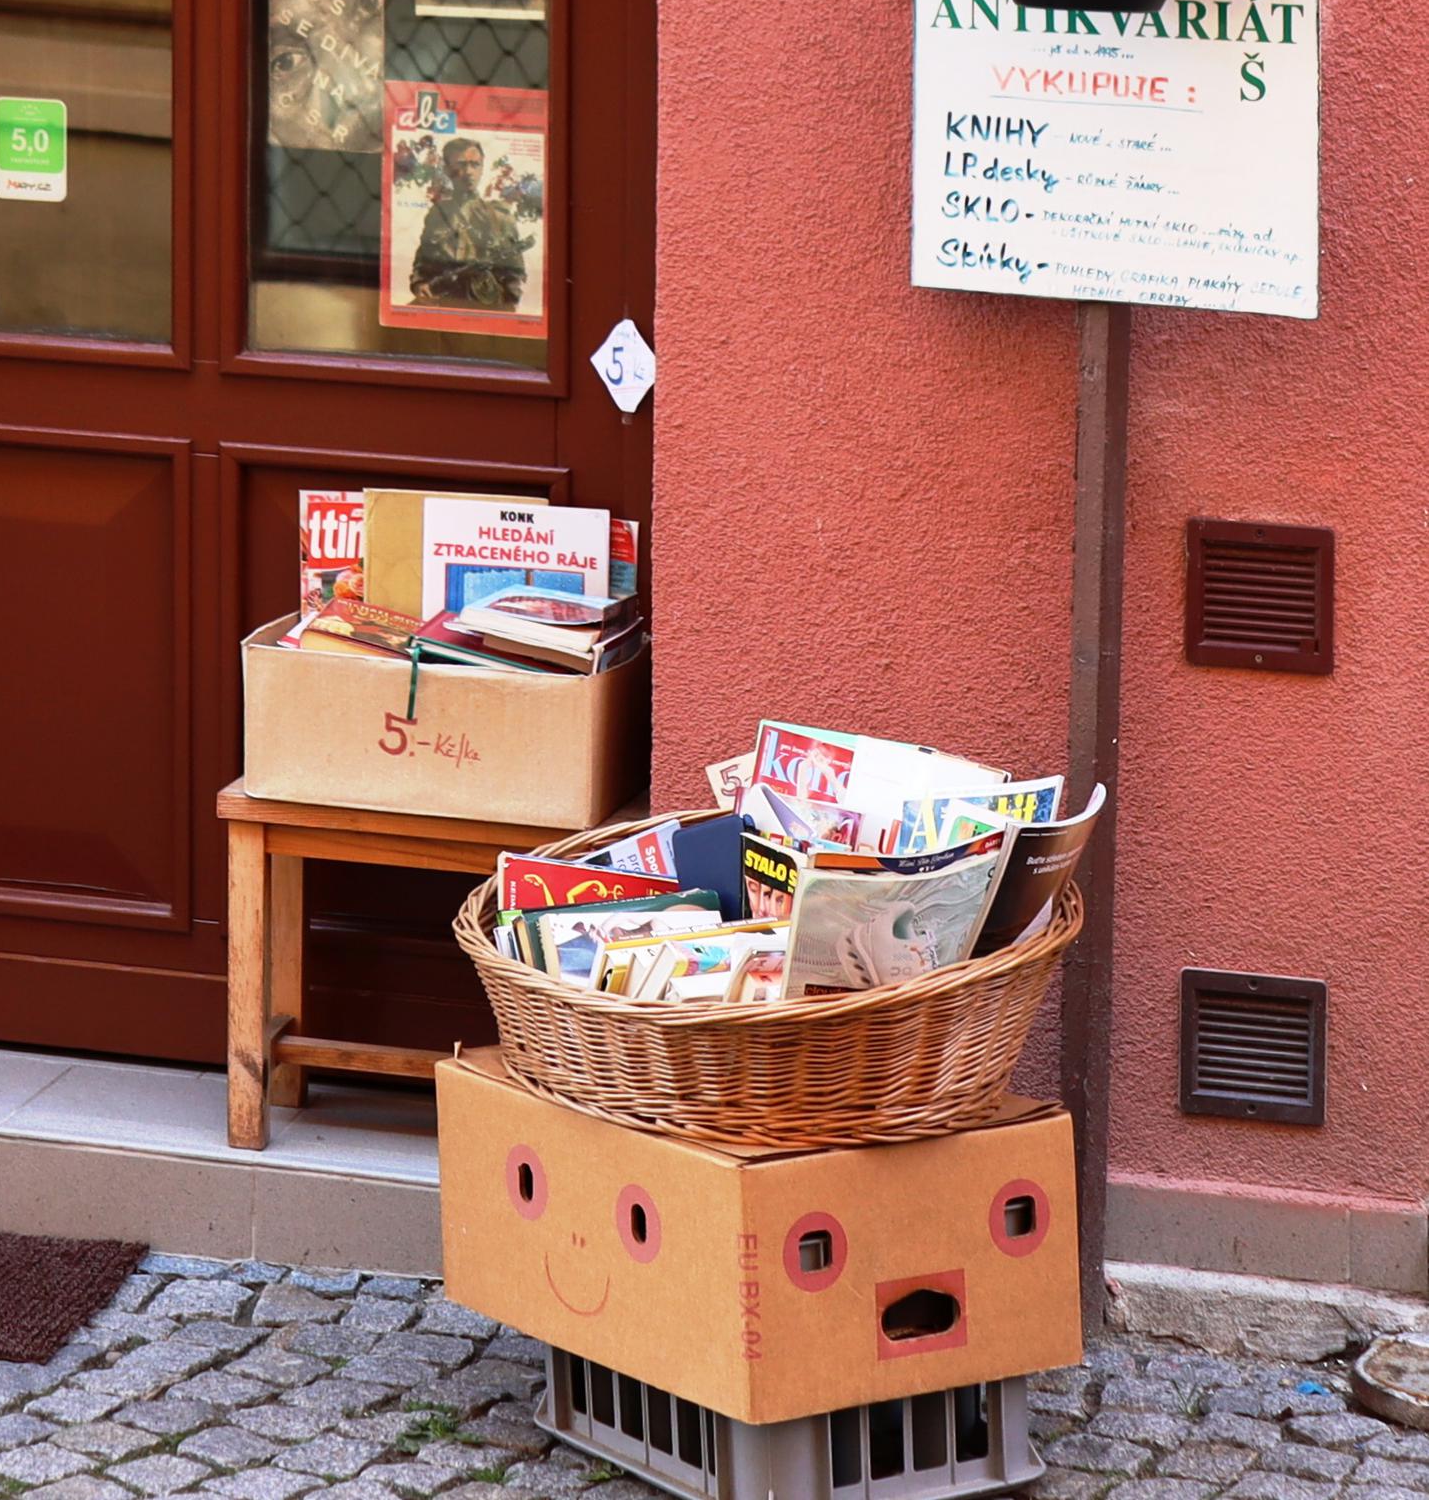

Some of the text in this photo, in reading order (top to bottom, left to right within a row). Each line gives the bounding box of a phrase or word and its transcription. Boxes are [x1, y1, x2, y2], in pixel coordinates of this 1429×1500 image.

[990, 64, 1169, 103] VYKUPUJE
[1239, 52, 1267, 102] Š
[399, 95, 449, 129] abc
[11, 127, 50, 156] 5,0
[945, 111, 1050, 148] KNIHY
[500, 510, 535, 524] KONK
[478, 525, 555, 546] HLEDÁNÍ
[433, 542, 598, 571] ZTRACENÉHO RÁJE
[745, 849, 787, 882] STALO
